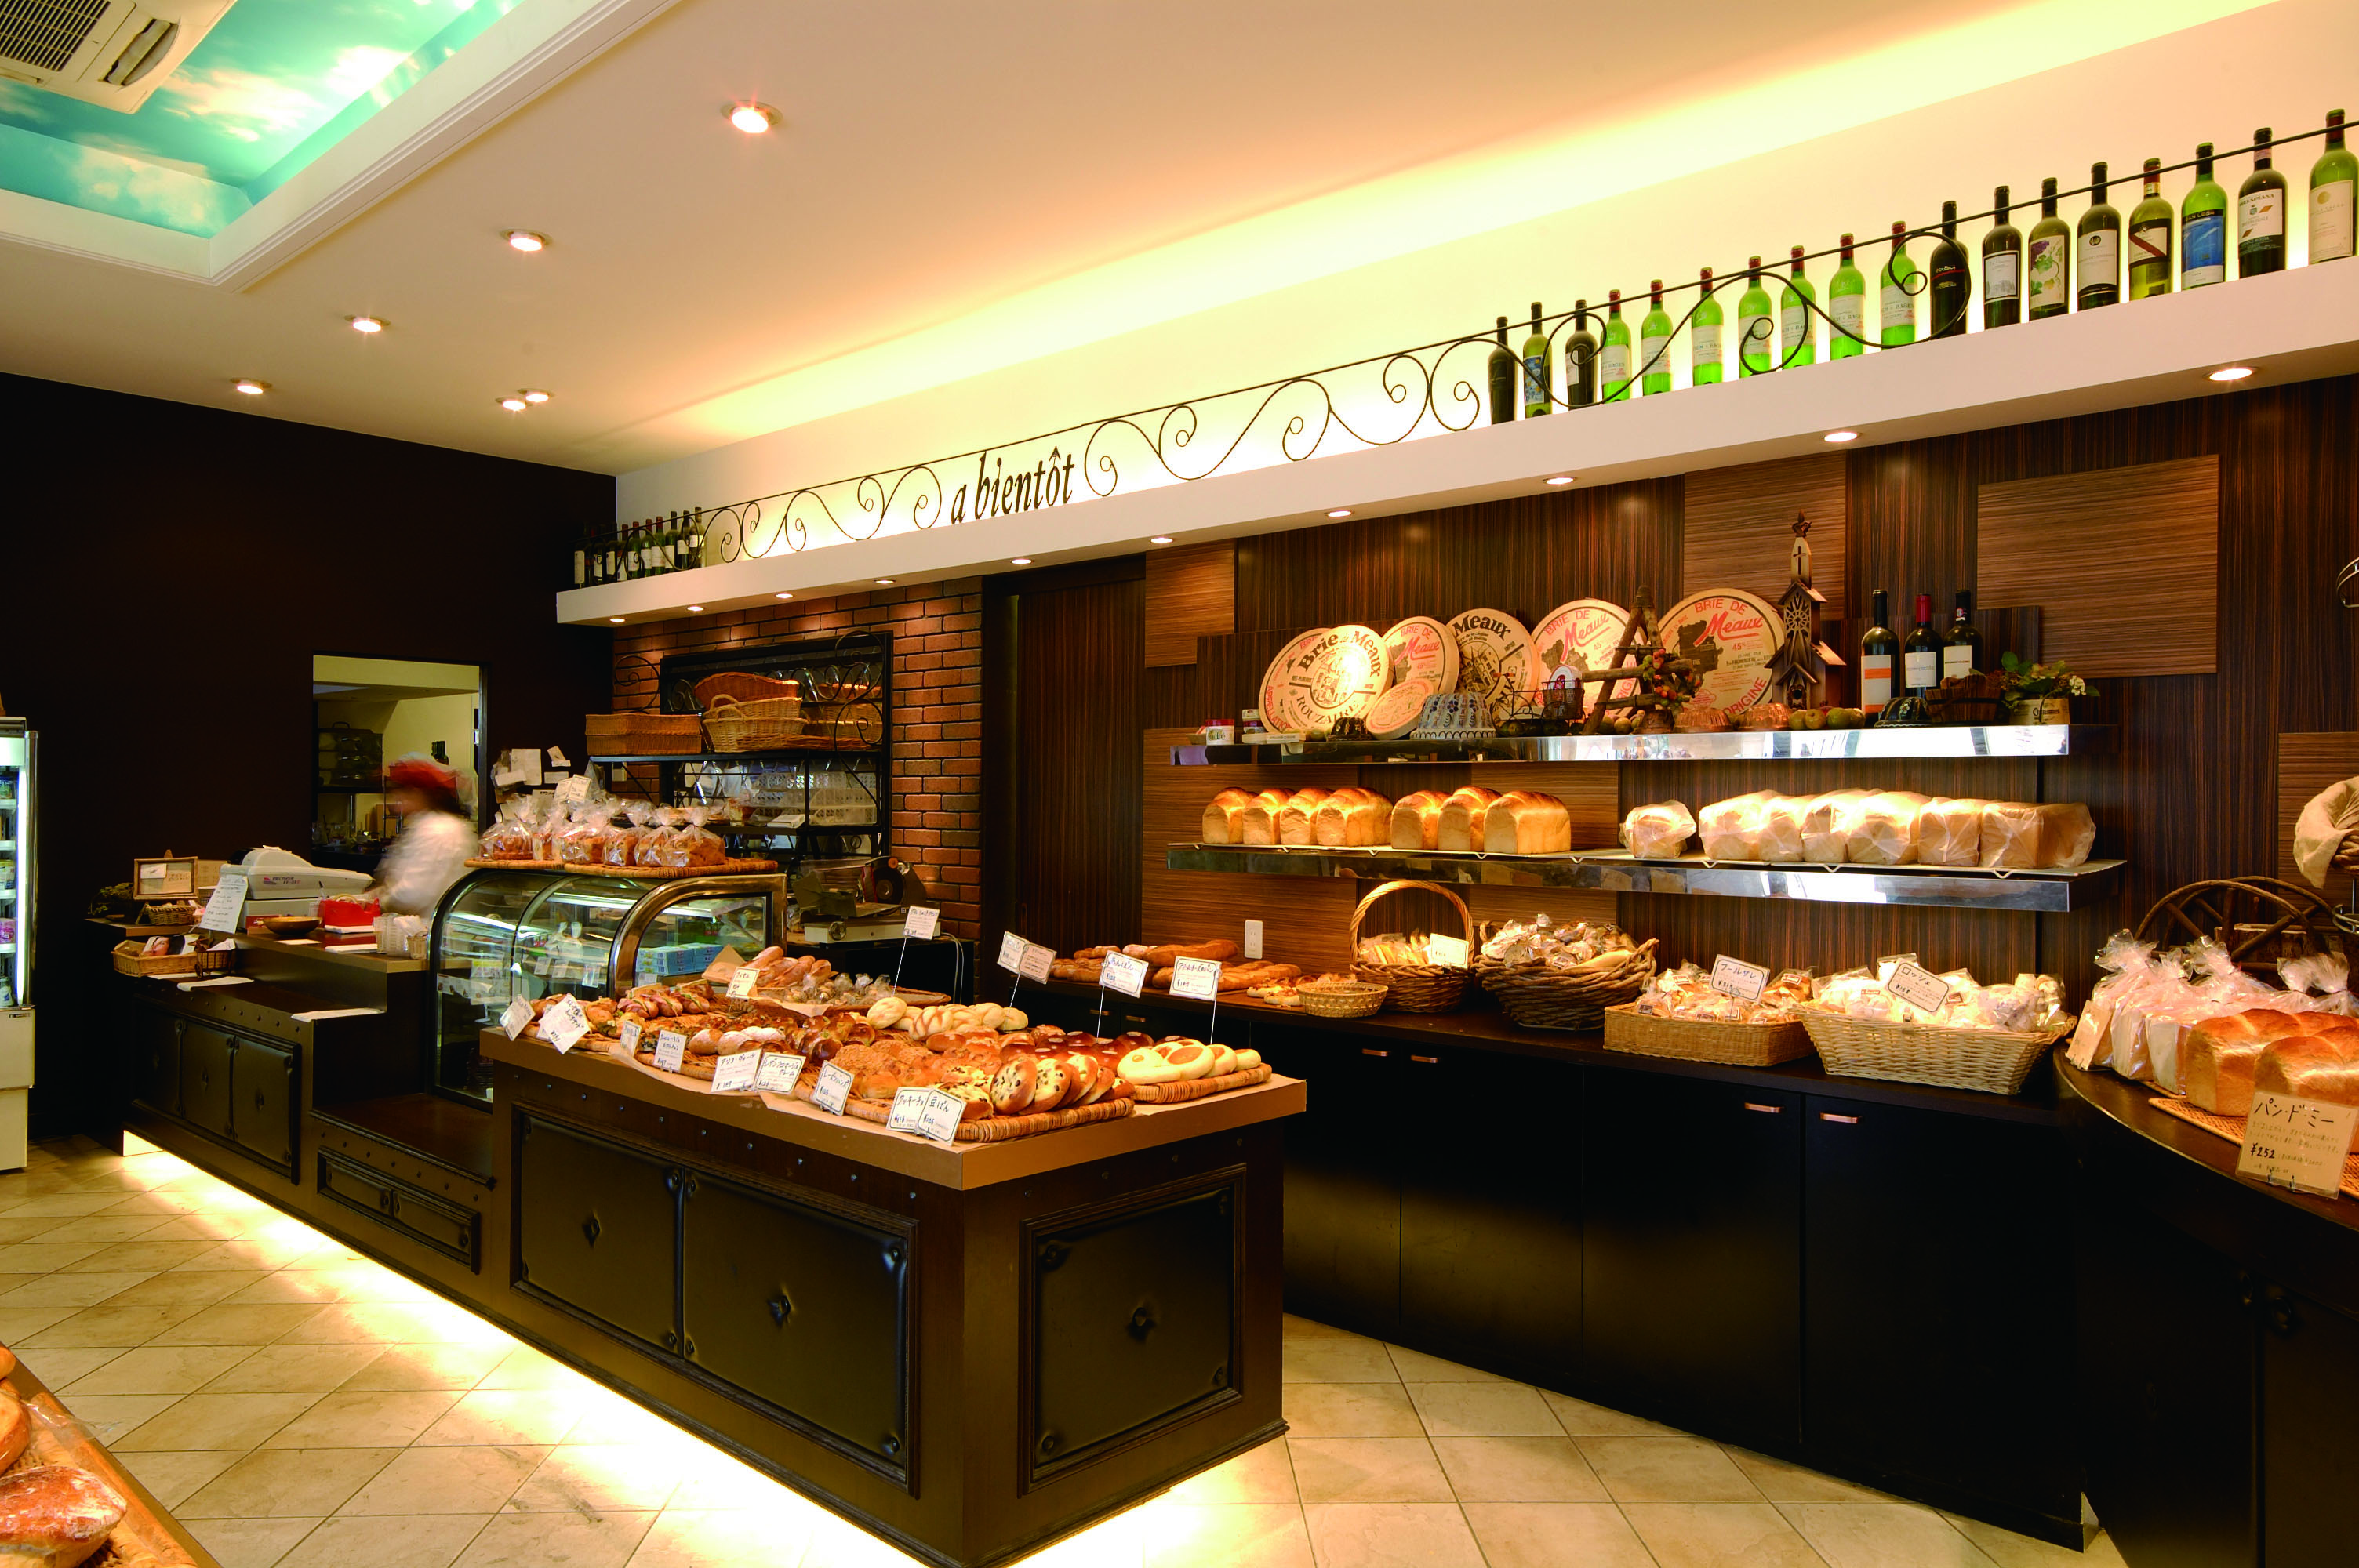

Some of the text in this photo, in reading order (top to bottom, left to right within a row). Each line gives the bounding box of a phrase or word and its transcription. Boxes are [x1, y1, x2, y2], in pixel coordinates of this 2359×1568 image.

[951, 446, 1075, 524] a bientôt
[1694, 598, 1748, 615] BRIE DE
[1401, 625, 1434, 640] BRIE DE
[1452, 615, 1511, 641] Meaux
[1543, 609, 1590, 636] BRIE DE
[1693, 611, 1764, 648] Meaux
[1394, 636, 1440, 665] Meaux
[1559, 613, 1611, 662] Meaux
[1298, 633, 1339, 672] Brie
[1350, 630, 1382, 678] Meaux
[1901, 966, 1932, 986] ロッシェ
[929, 1096, 950, 1112] 豆ぱん
[2250, 1142, 2275, 1160] ¥252
